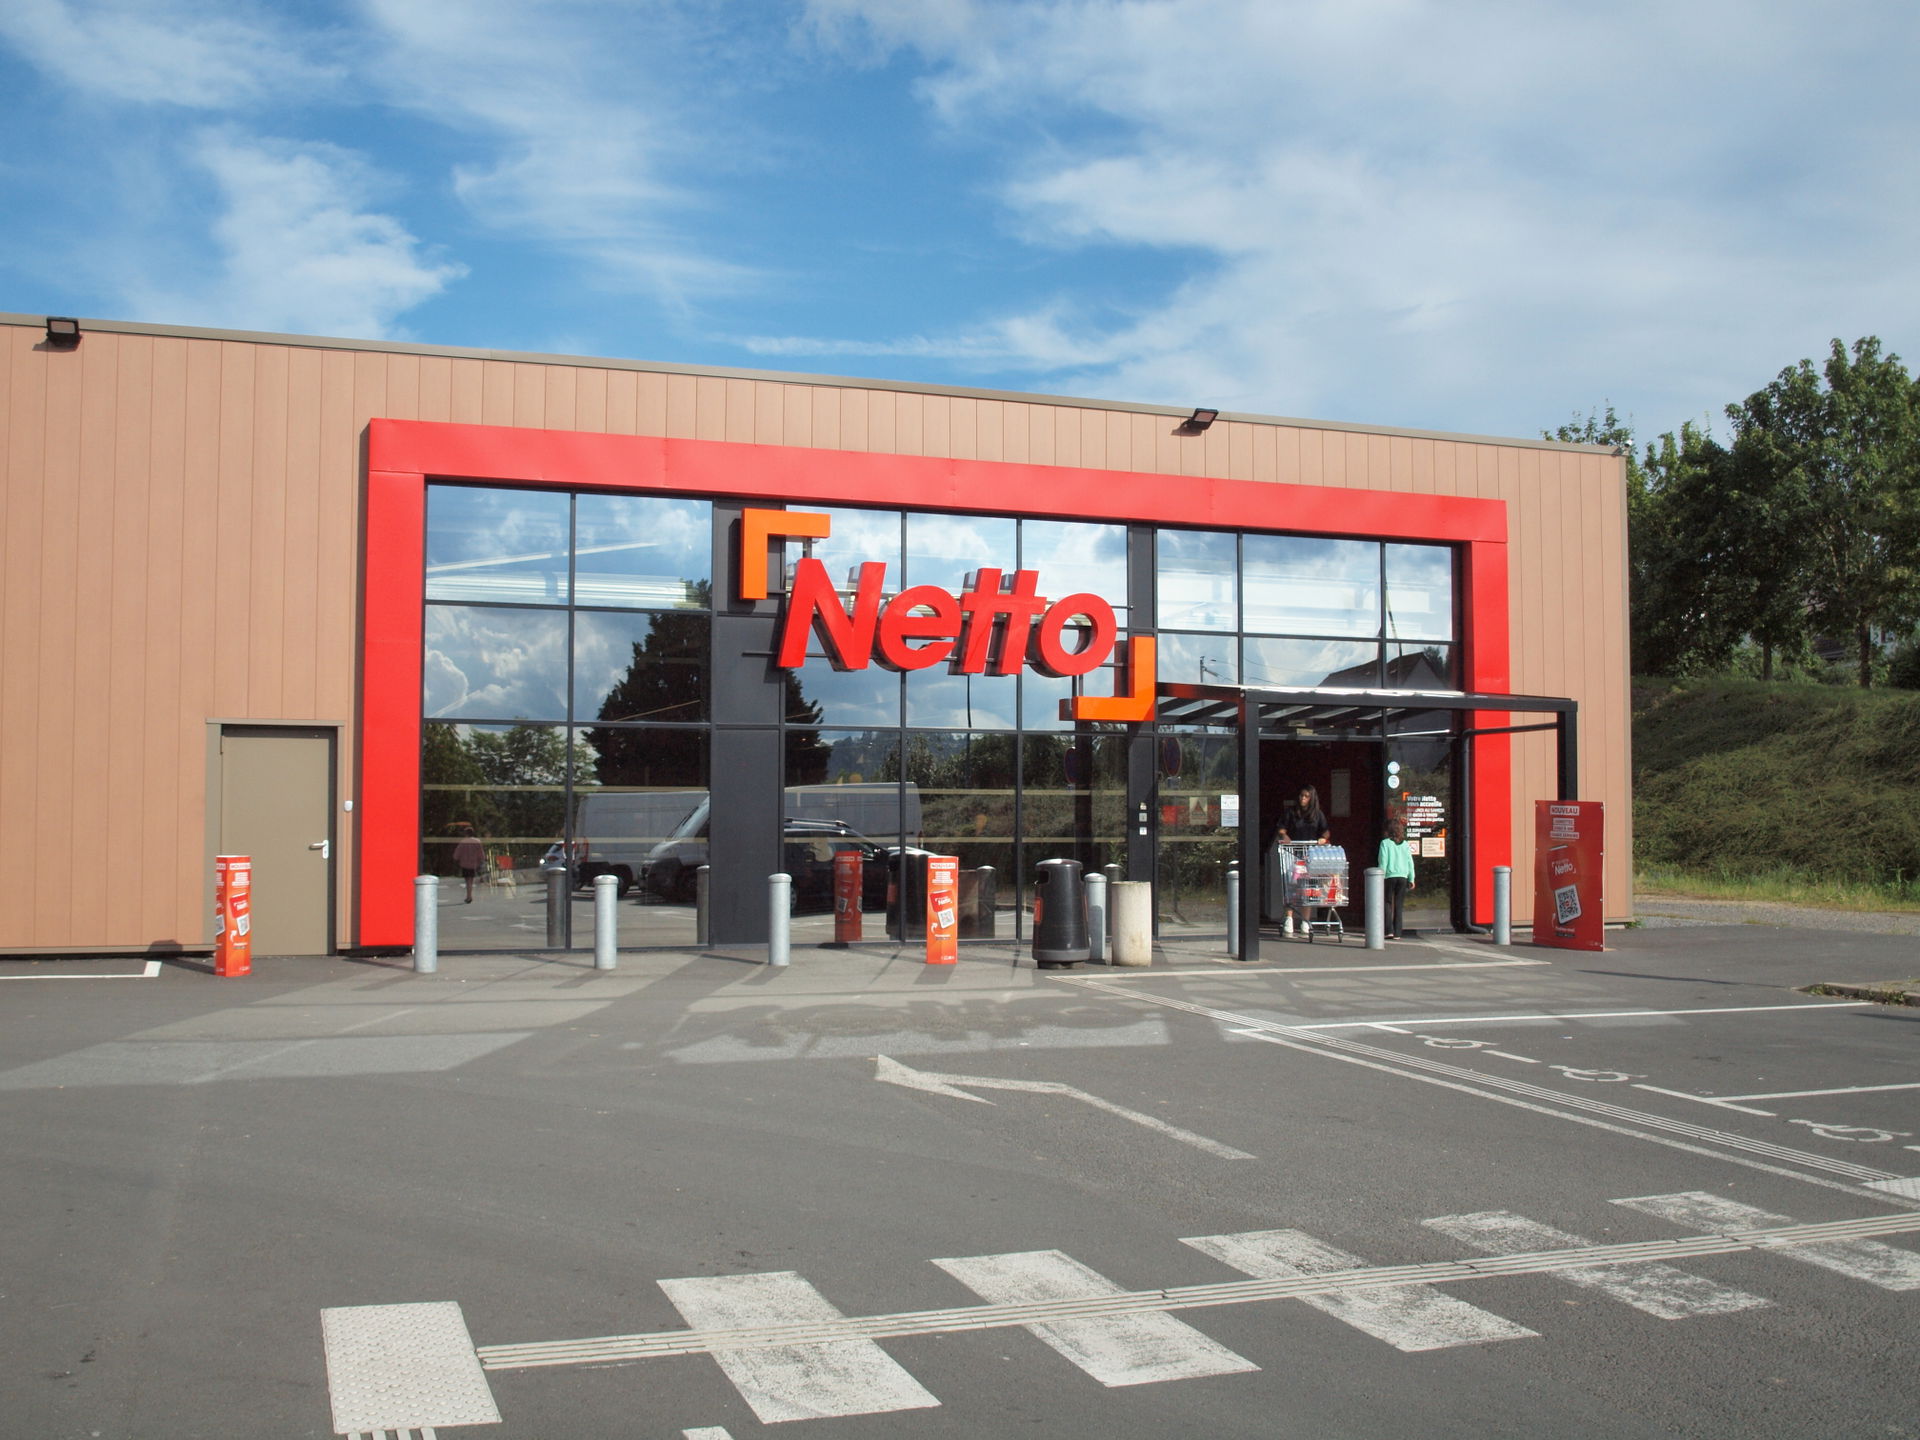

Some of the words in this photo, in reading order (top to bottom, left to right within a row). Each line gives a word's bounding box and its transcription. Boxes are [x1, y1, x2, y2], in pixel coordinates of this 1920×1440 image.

[777, 558, 1117, 677] Netto
[1551, 806, 1578, 815] NOUVEAU
[1554, 863, 1574, 876] Netto
